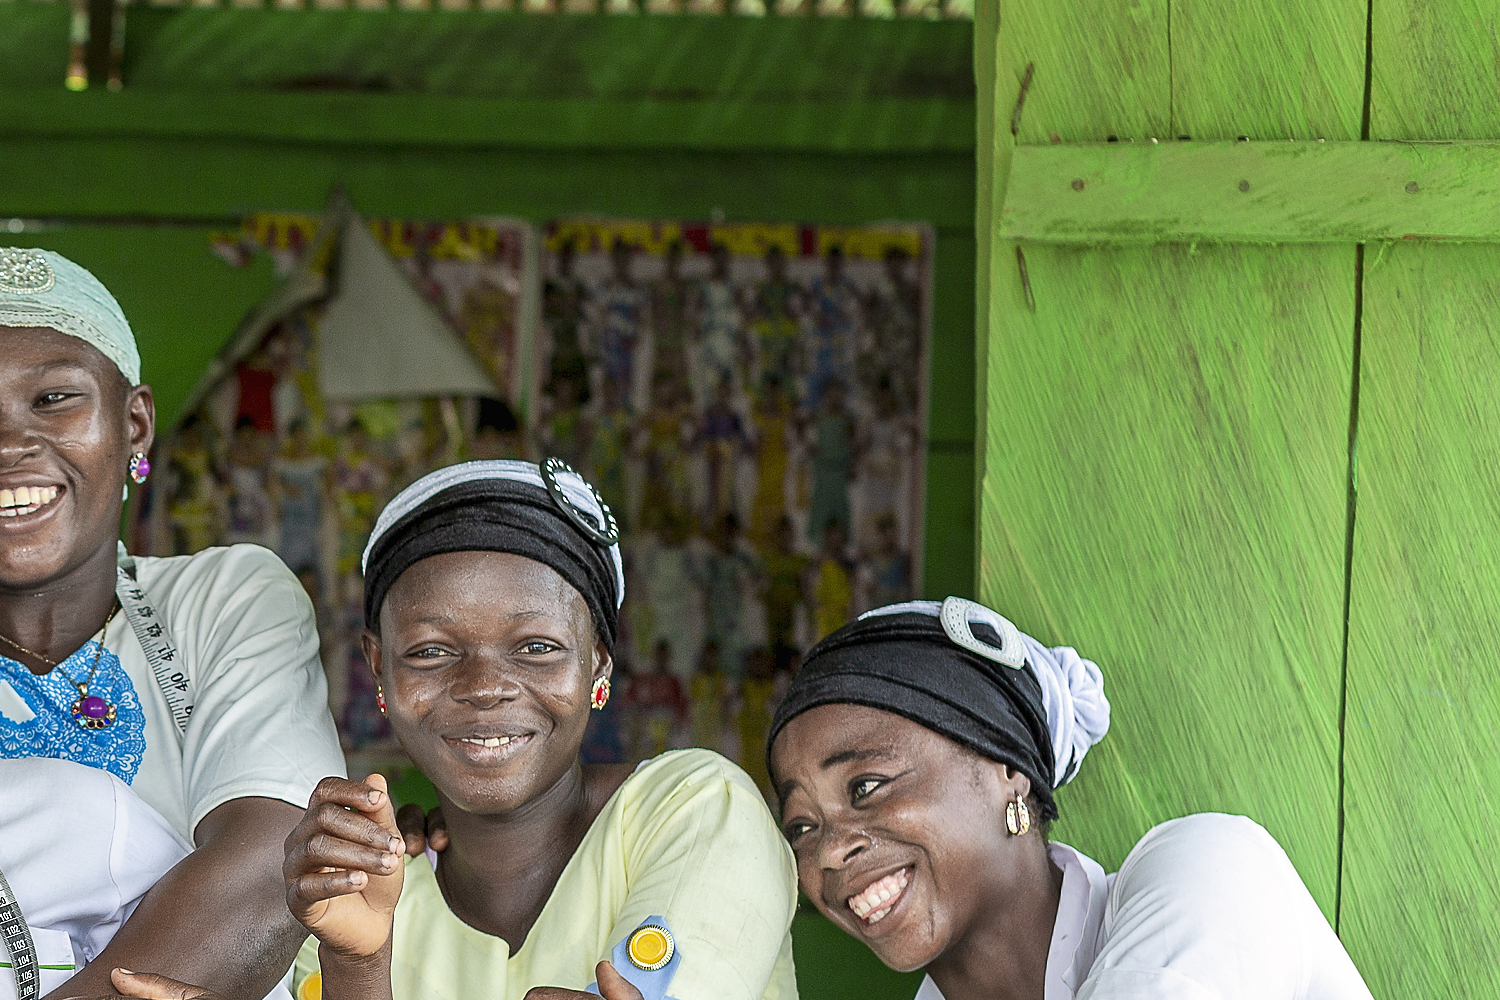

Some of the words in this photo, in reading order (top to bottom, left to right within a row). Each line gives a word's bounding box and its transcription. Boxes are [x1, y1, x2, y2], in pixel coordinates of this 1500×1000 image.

[146, 622, 163, 638] 42
[158, 642, 175, 662] 41
[170, 671, 189, 692] 40
[0, 910, 13, 922] 101
[5, 924, 21, 936] 102
[12, 939, 26, 951] 103
[17, 954, 30, 966] 104
[21, 969, 33, 981] 105
[22, 984, 34, 996] 106
